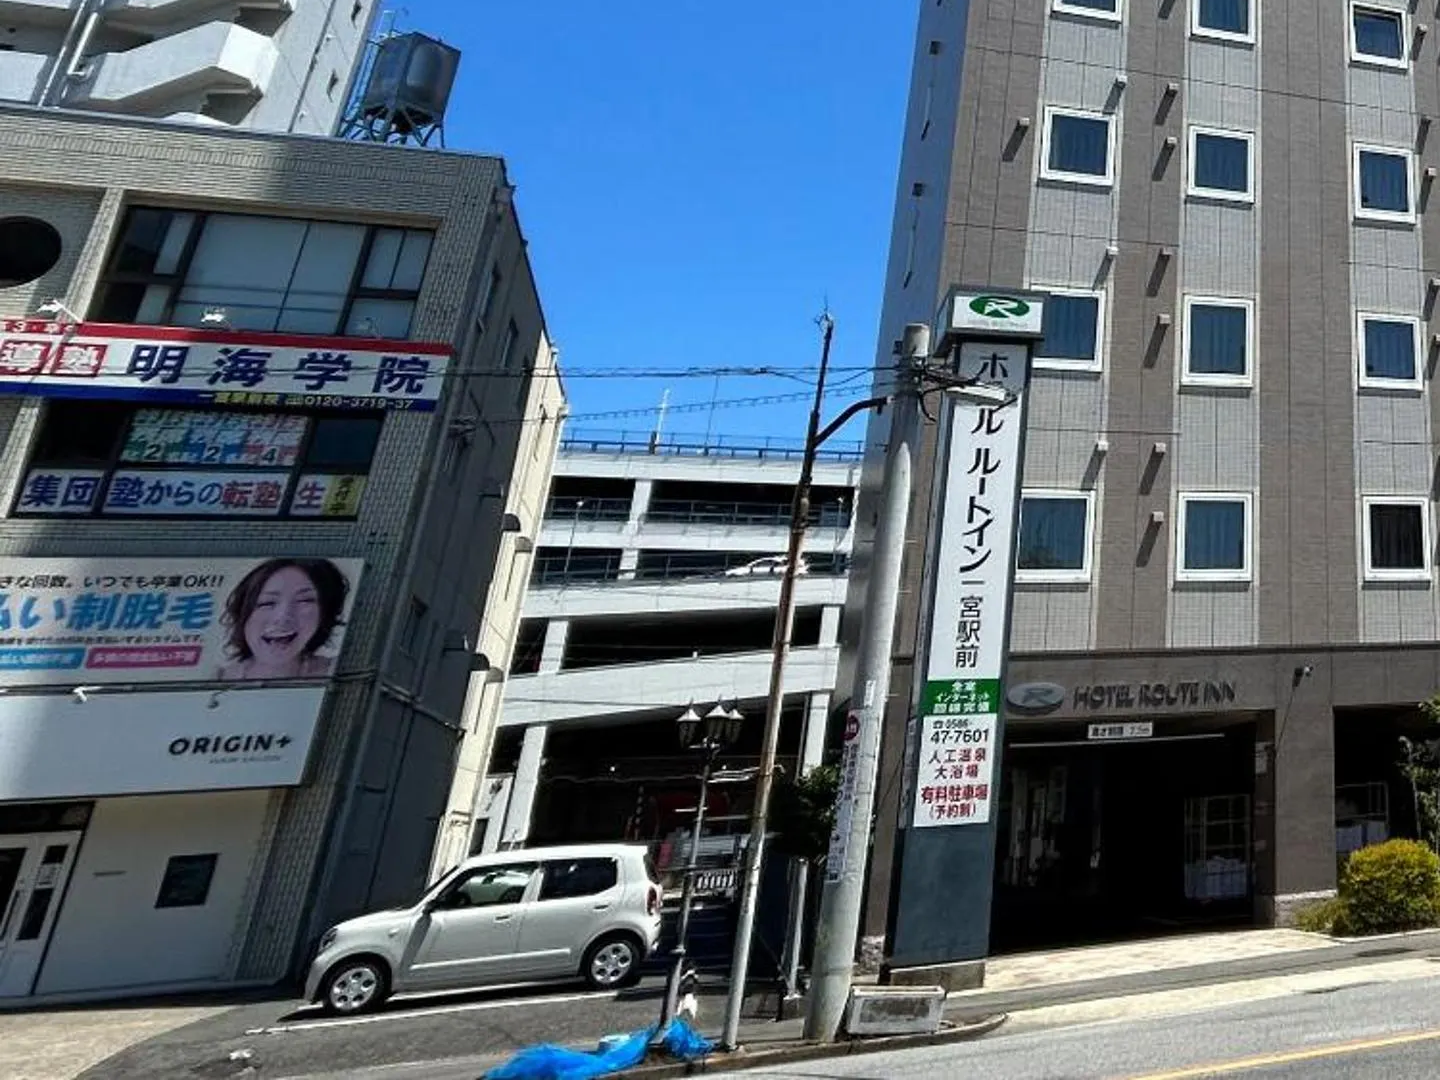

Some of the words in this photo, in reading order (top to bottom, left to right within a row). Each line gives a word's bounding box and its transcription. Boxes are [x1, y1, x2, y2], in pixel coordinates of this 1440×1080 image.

[127, 344, 430, 394] 明海学院
[1073, 683, 1135, 710] HOTEL
[1137, 682, 1199, 707] ROUTE
[1203, 681, 1236, 704] INN
[930, 728, 989, 744] 47-7601
[928, 747, 986, 764] 人工温泉
[934, 764, 979, 780] 大浴場
[921, 784, 989, 805] 有料駐車場
